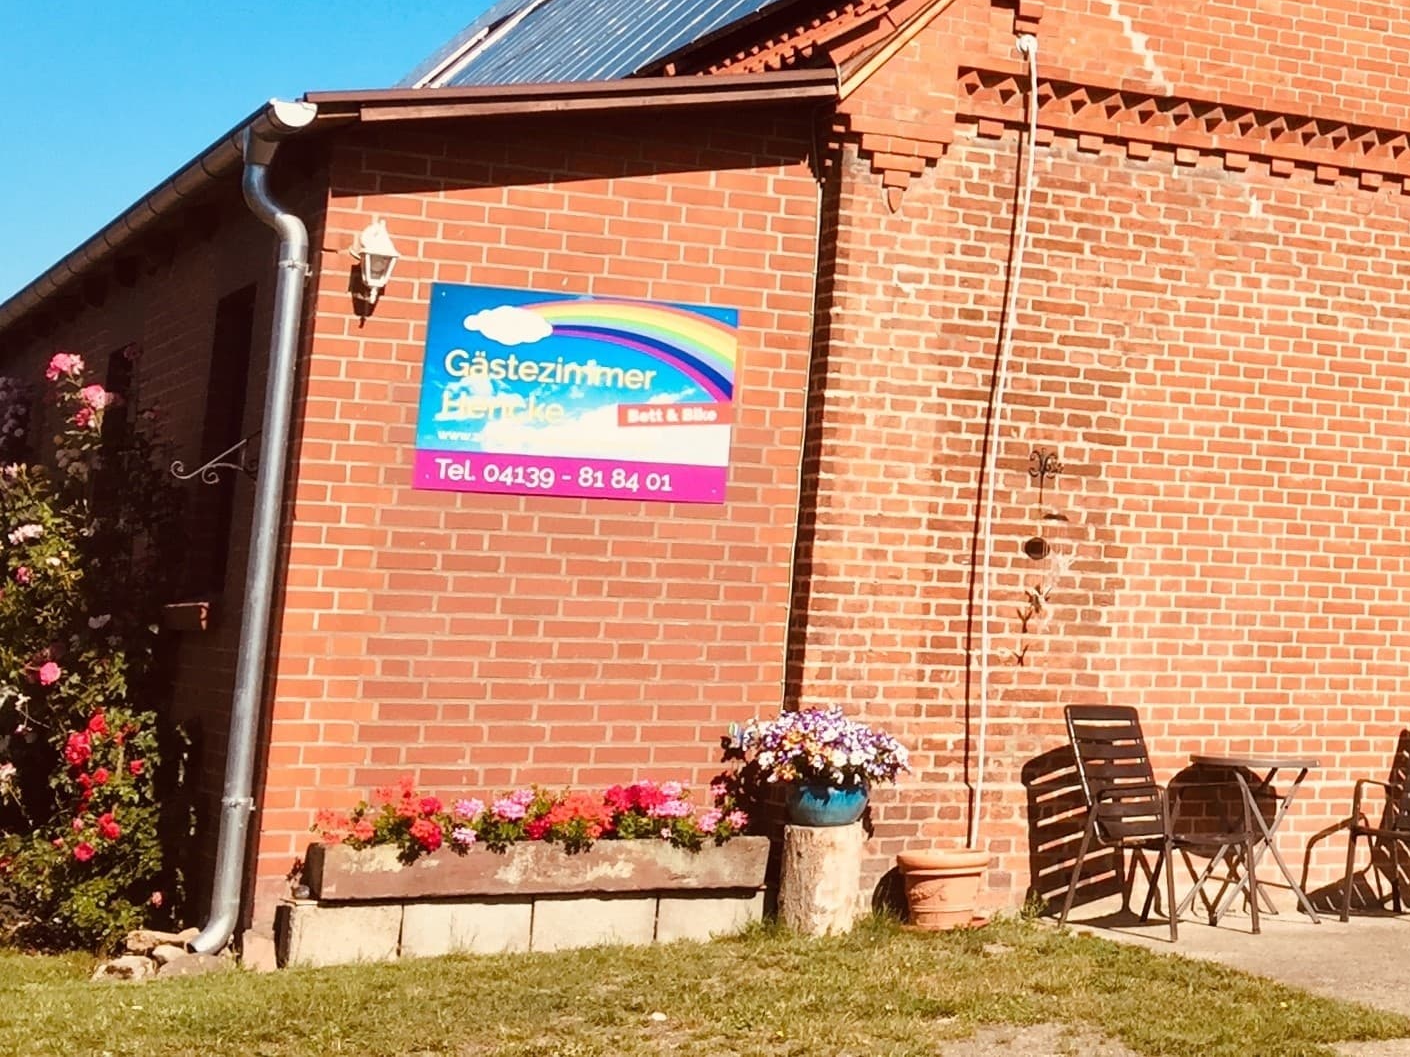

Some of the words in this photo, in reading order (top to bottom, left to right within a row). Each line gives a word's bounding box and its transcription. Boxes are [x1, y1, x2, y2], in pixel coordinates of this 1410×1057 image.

[444, 348, 657, 390] Gästezimmer
[626, 407, 664, 423] Bett
[666, 407, 679, 422] &
[681, 406, 718, 422] Bike
[434, 457, 476, 481] Tel.
[483, 463, 556, 489] 04139
[577, 465, 605, 487] 81
[610, 467, 639, 493] 84
[645, 471, 672, 491] 01
